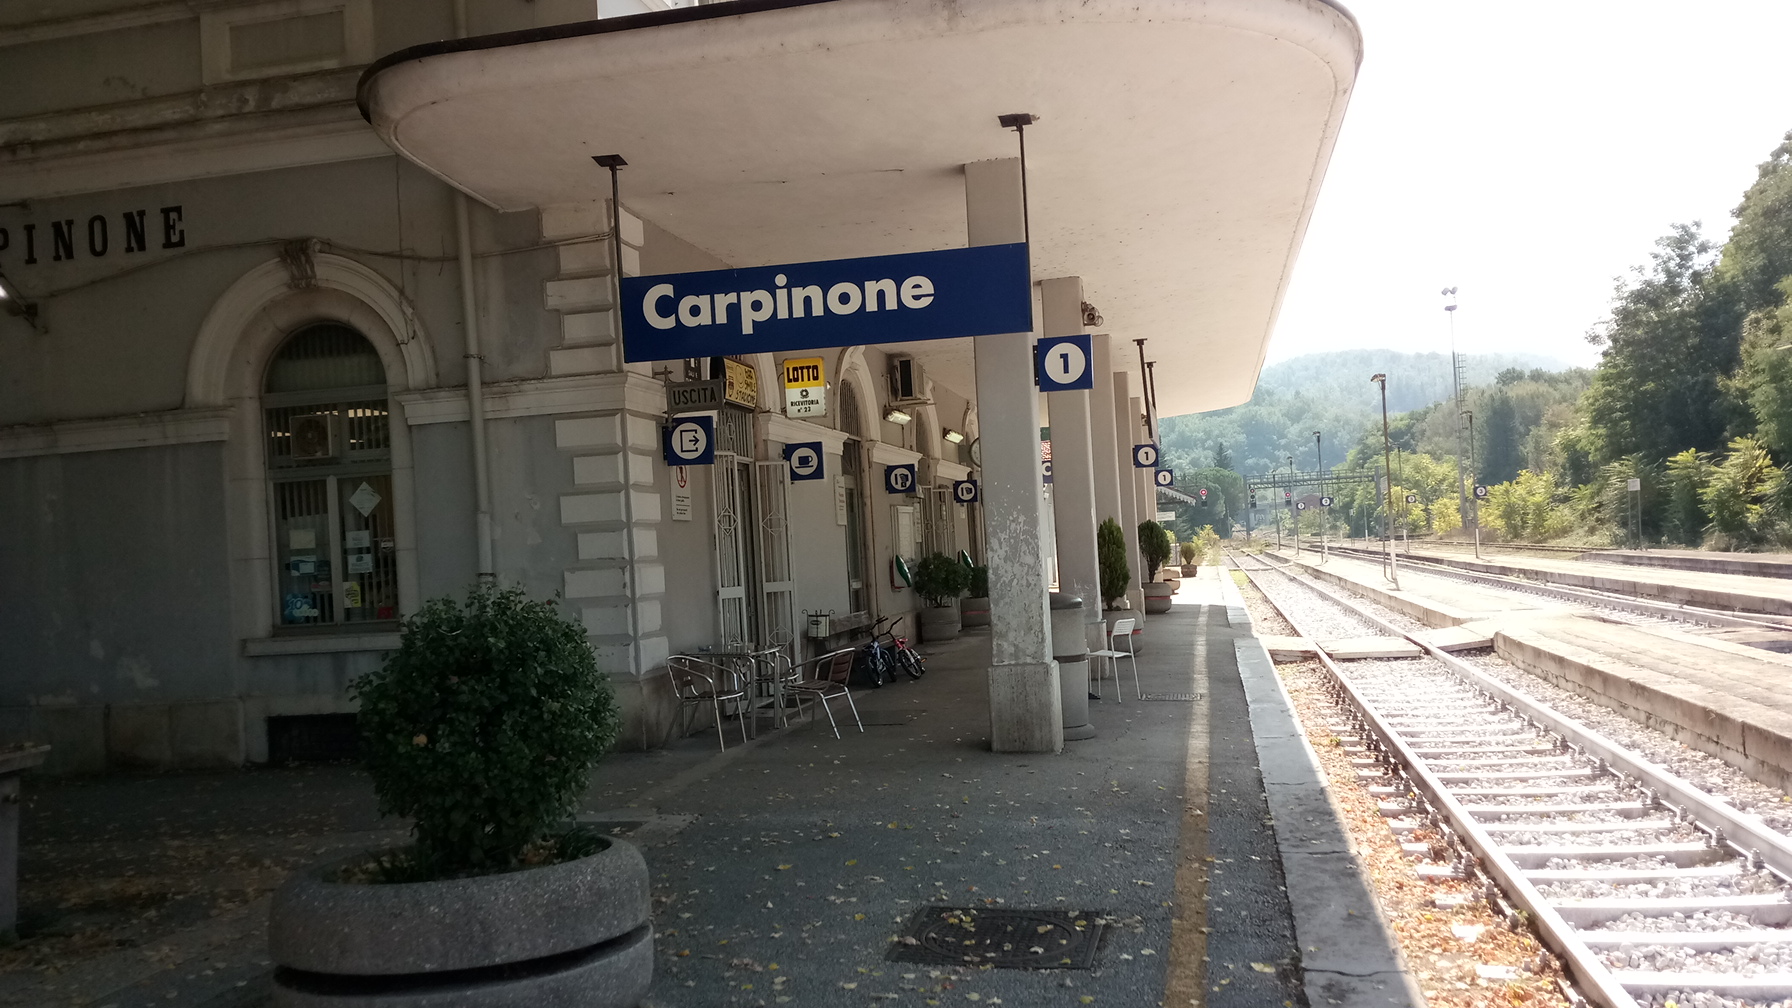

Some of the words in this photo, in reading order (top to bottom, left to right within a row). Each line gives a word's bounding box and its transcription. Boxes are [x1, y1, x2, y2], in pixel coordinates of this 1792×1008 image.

[642, 273, 935, 335] Carpinone
[1060, 353, 1070, 374] 1
[786, 364, 820, 383] LOTTO
[673, 386, 717, 406] USCITA
[790, 399, 820, 407] RICEVITORIA
[1144, 451, 1149, 461] 1
